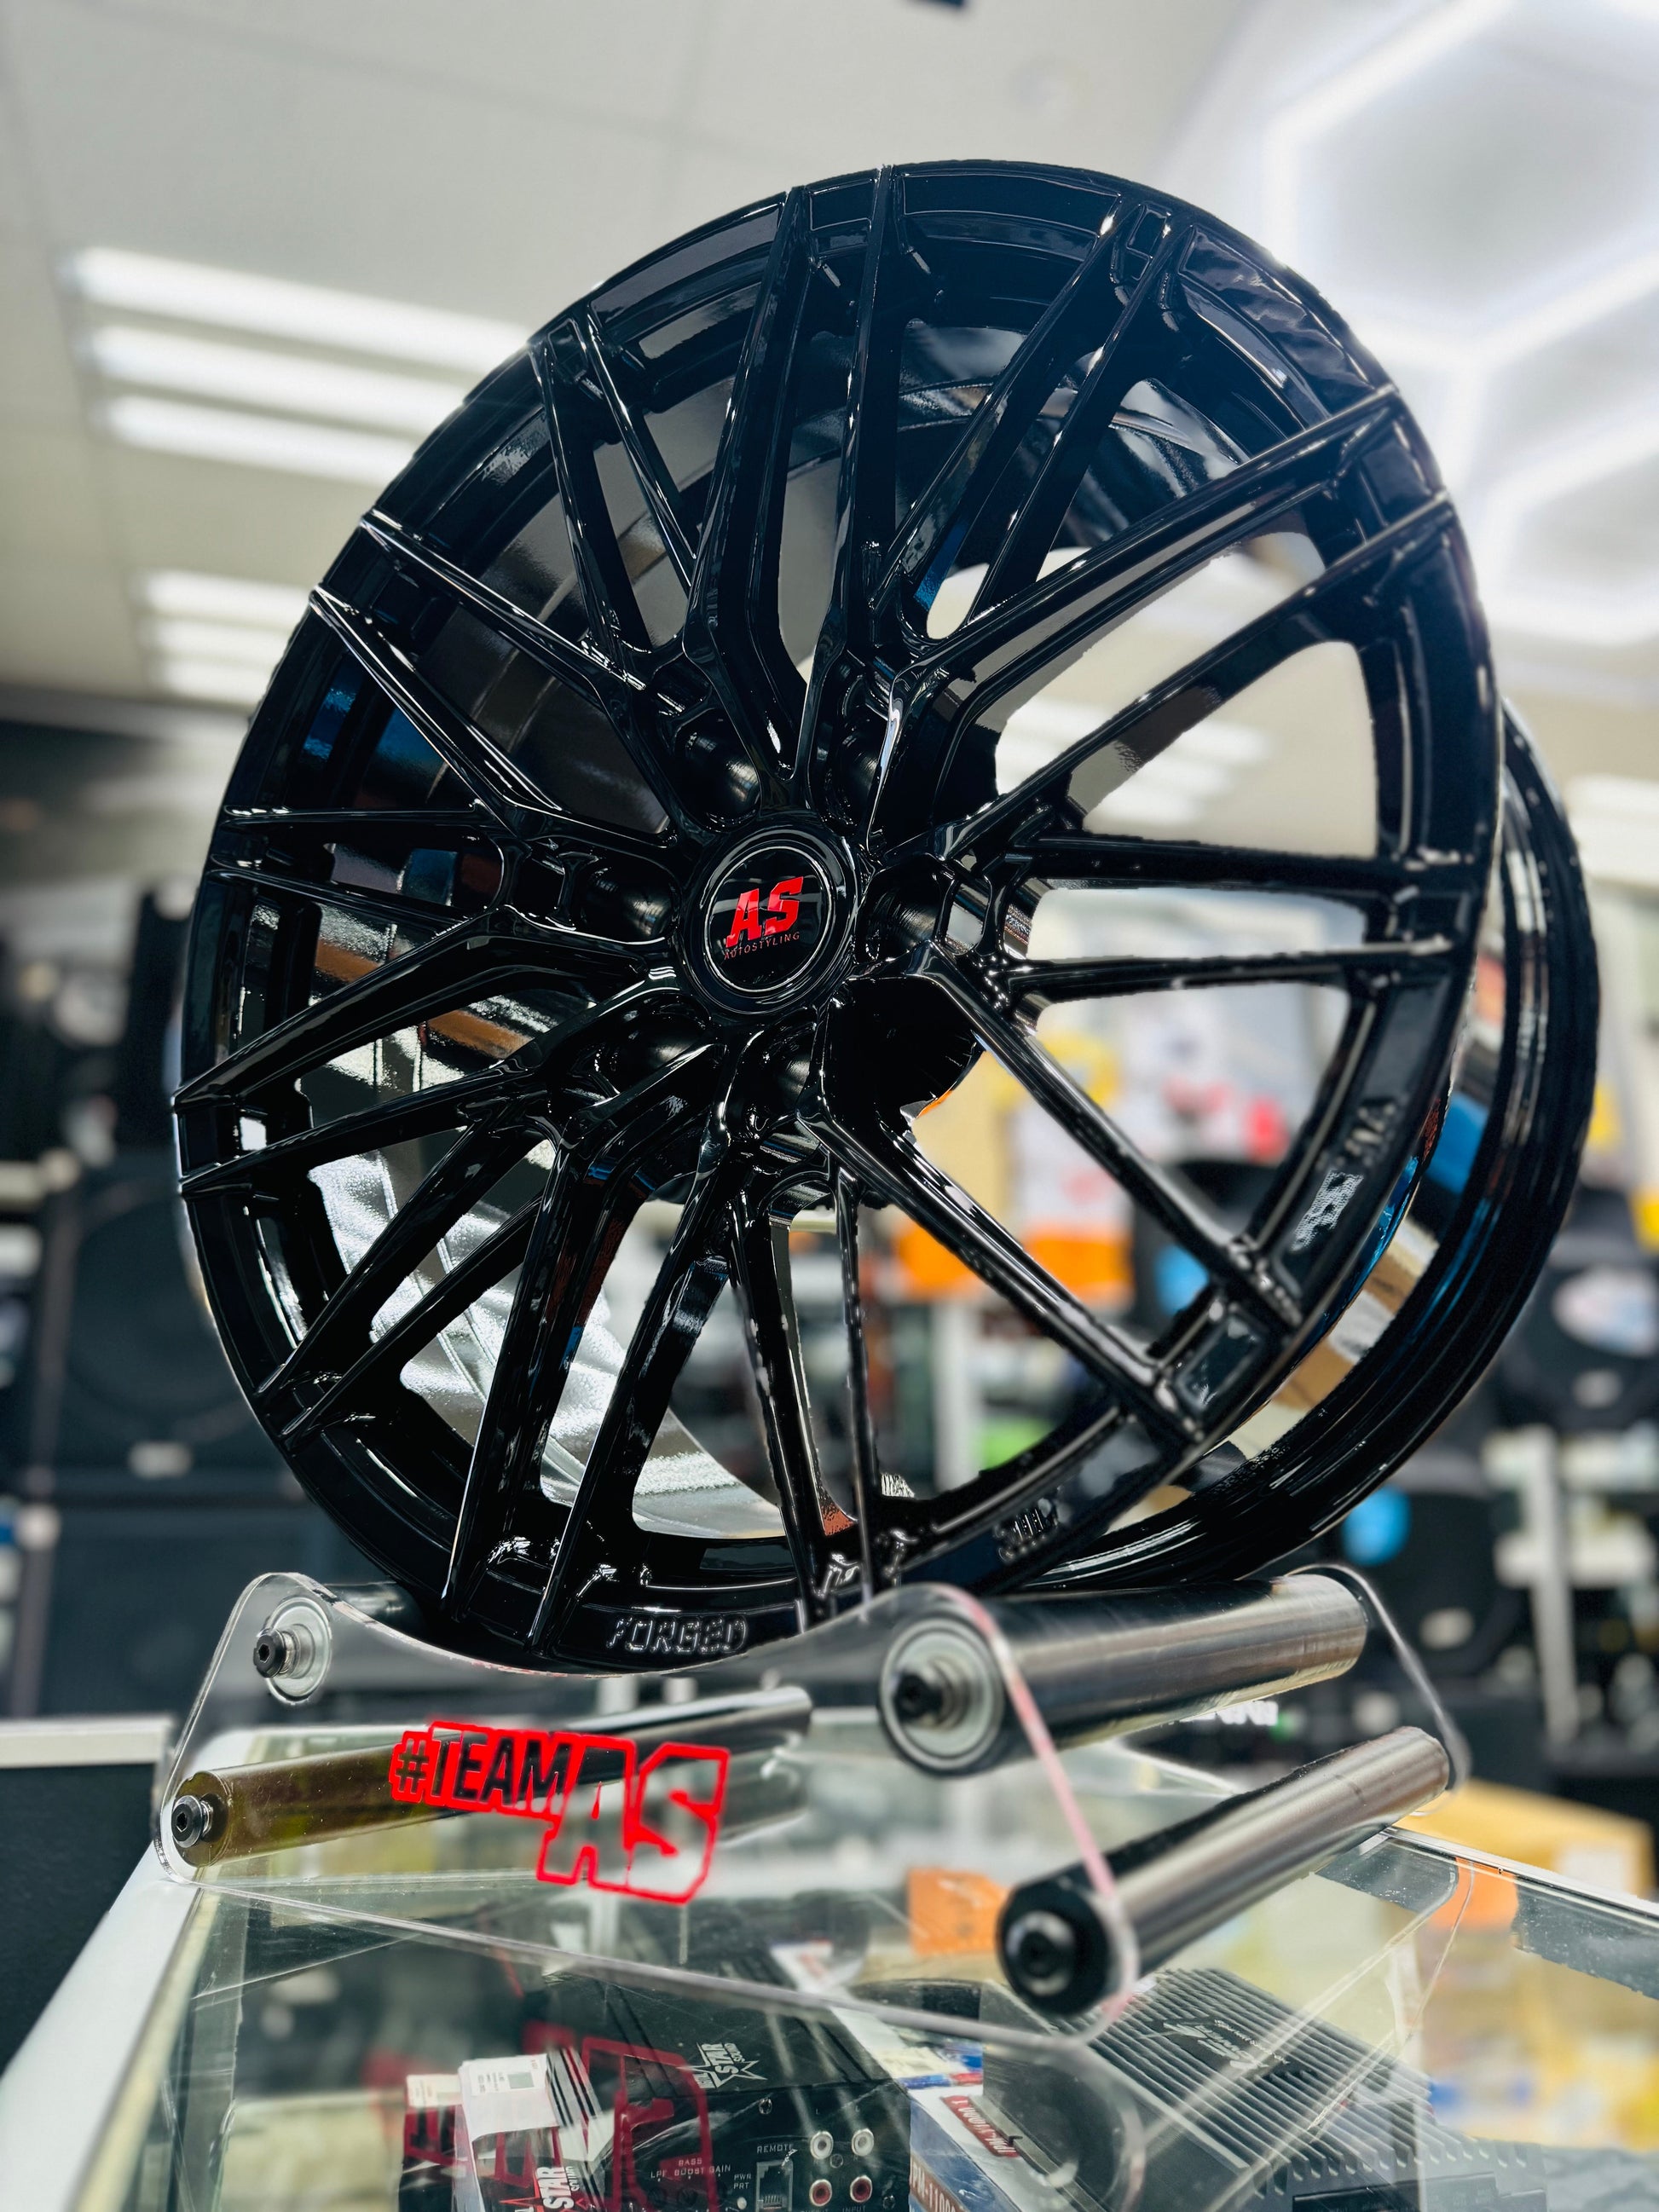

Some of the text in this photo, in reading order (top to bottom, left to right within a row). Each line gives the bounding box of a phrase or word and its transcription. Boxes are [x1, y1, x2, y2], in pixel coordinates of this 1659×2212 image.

[726, 876, 803, 948] AS
[724, 932, 800, 960] AUTOSTYLING
[606, 1617, 748, 1654] FORGED
[391, 1725, 730, 1904] #TEAM AS
[701, 2042, 739, 2074] STAR
[678, 2157, 702, 2166] BASS
[756, 2143, 794, 2154] REMOTE
[708, 2164, 731, 2174] GAIN
[536, 2166, 575, 2209] STAR
